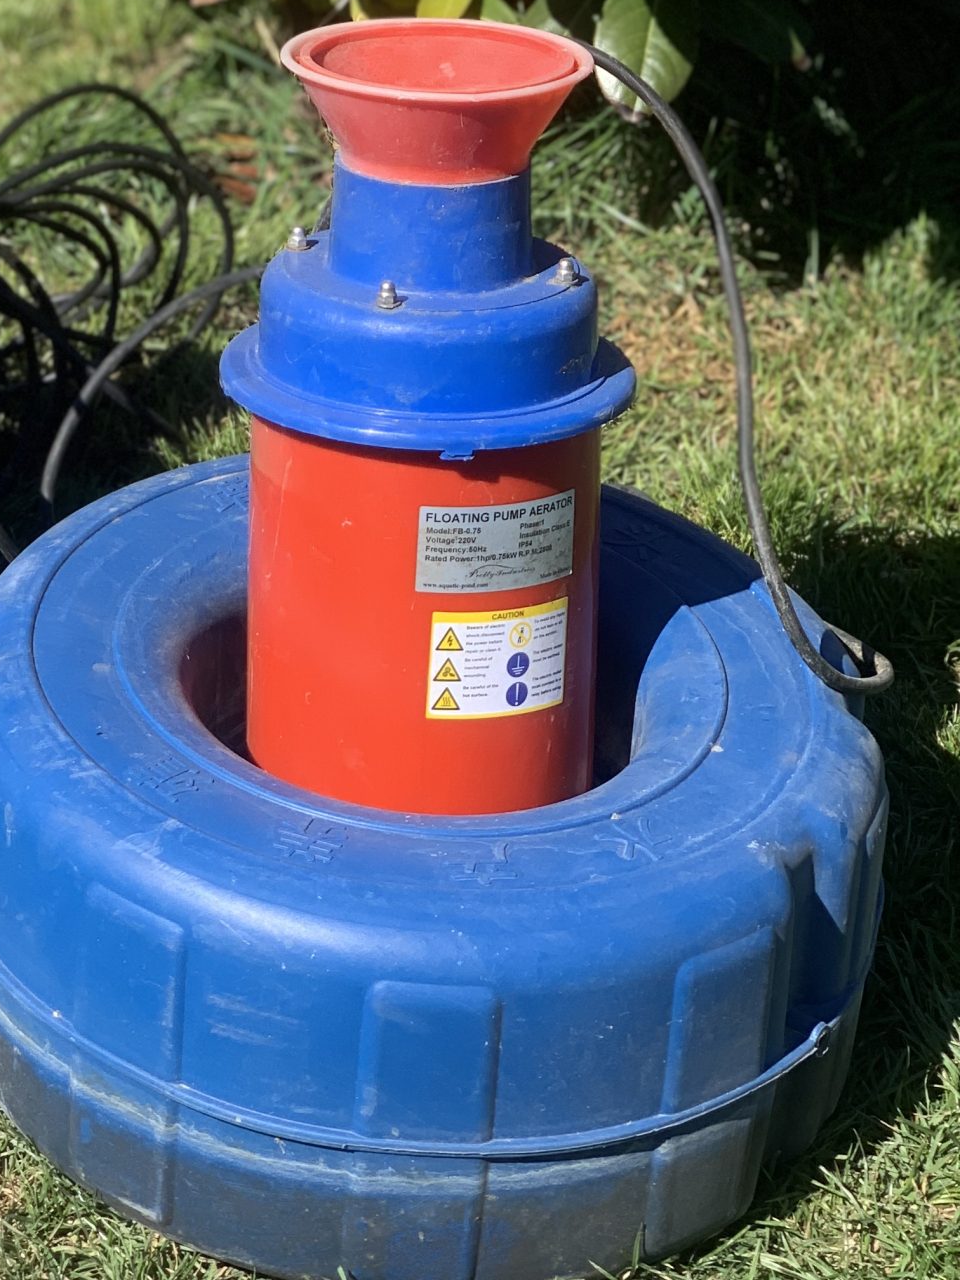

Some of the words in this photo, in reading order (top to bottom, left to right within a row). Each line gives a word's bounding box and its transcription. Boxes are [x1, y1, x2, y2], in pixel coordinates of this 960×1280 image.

[426, 513, 489, 523] FLOATING
[494, 509, 526, 522] PUMP
[529, 496, 573, 517] AERATOR
[519, 528, 550, 539] Insulation
[518, 540, 533, 548] IP54
[492, 611, 524, 620] CAUTION
